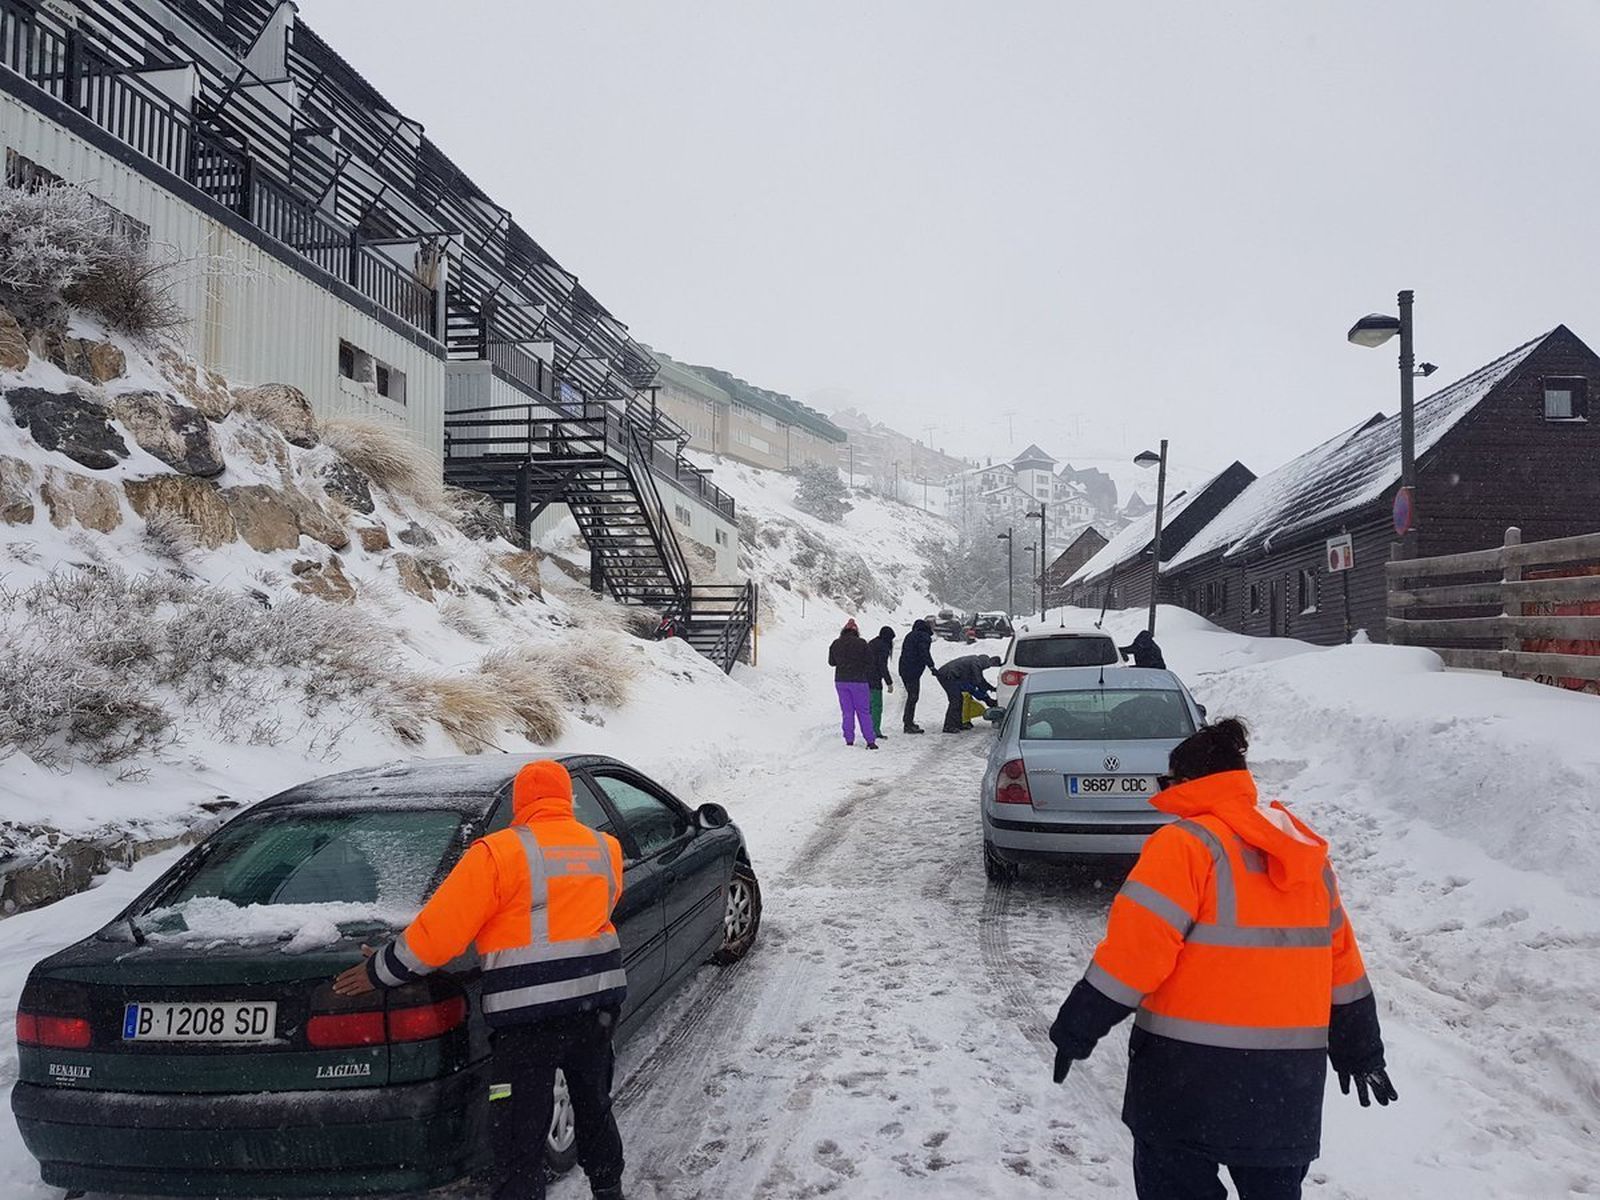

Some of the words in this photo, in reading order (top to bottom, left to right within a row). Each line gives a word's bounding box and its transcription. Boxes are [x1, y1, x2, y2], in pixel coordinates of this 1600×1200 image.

[1082, 778, 1115, 792] 9687
[138, 1007, 153, 1035] B
[166, 1007, 225, 1035] 1208
[234, 1007, 269, 1035] SD
[48, 1063, 92, 1078] RENAULT
[316, 1063, 371, 1079] LAGUNA
